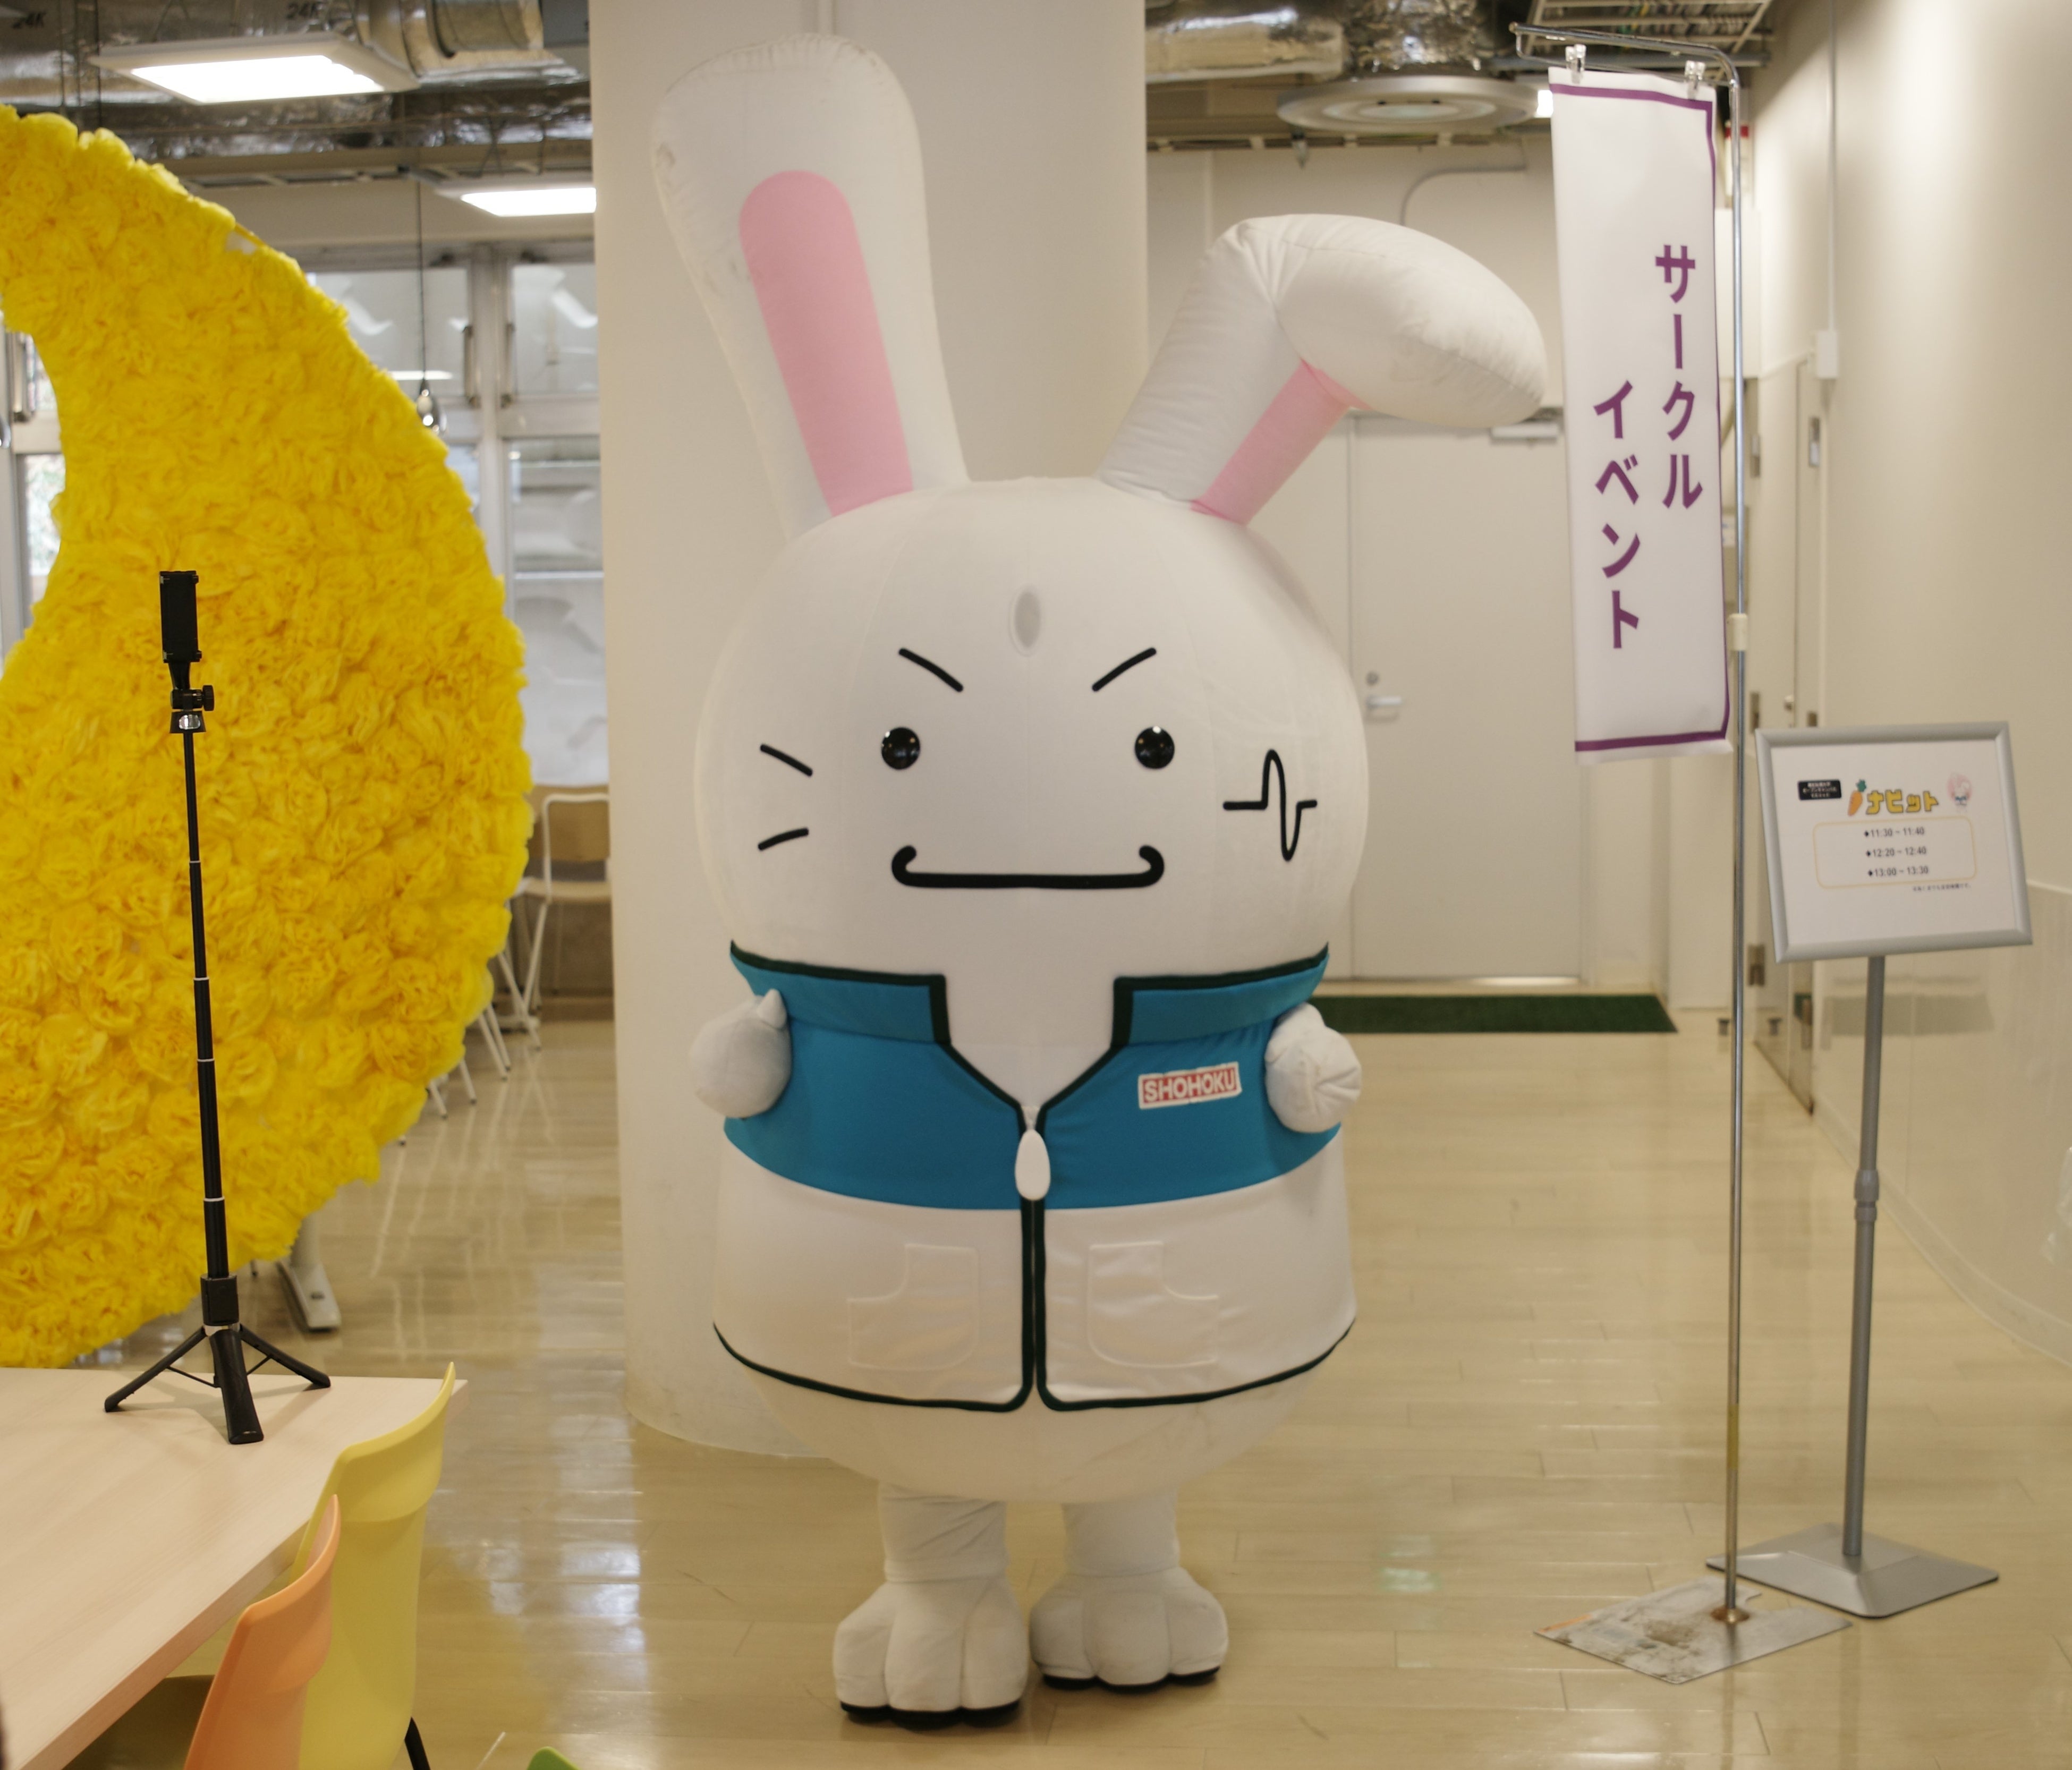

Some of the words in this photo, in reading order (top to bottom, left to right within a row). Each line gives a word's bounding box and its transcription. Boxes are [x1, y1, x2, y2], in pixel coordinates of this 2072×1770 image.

[1655, 244, 1703, 509] サークル
[1593, 381, 1641, 650] イベント
[1144, 1069, 1235, 1102] SHOHOKU
